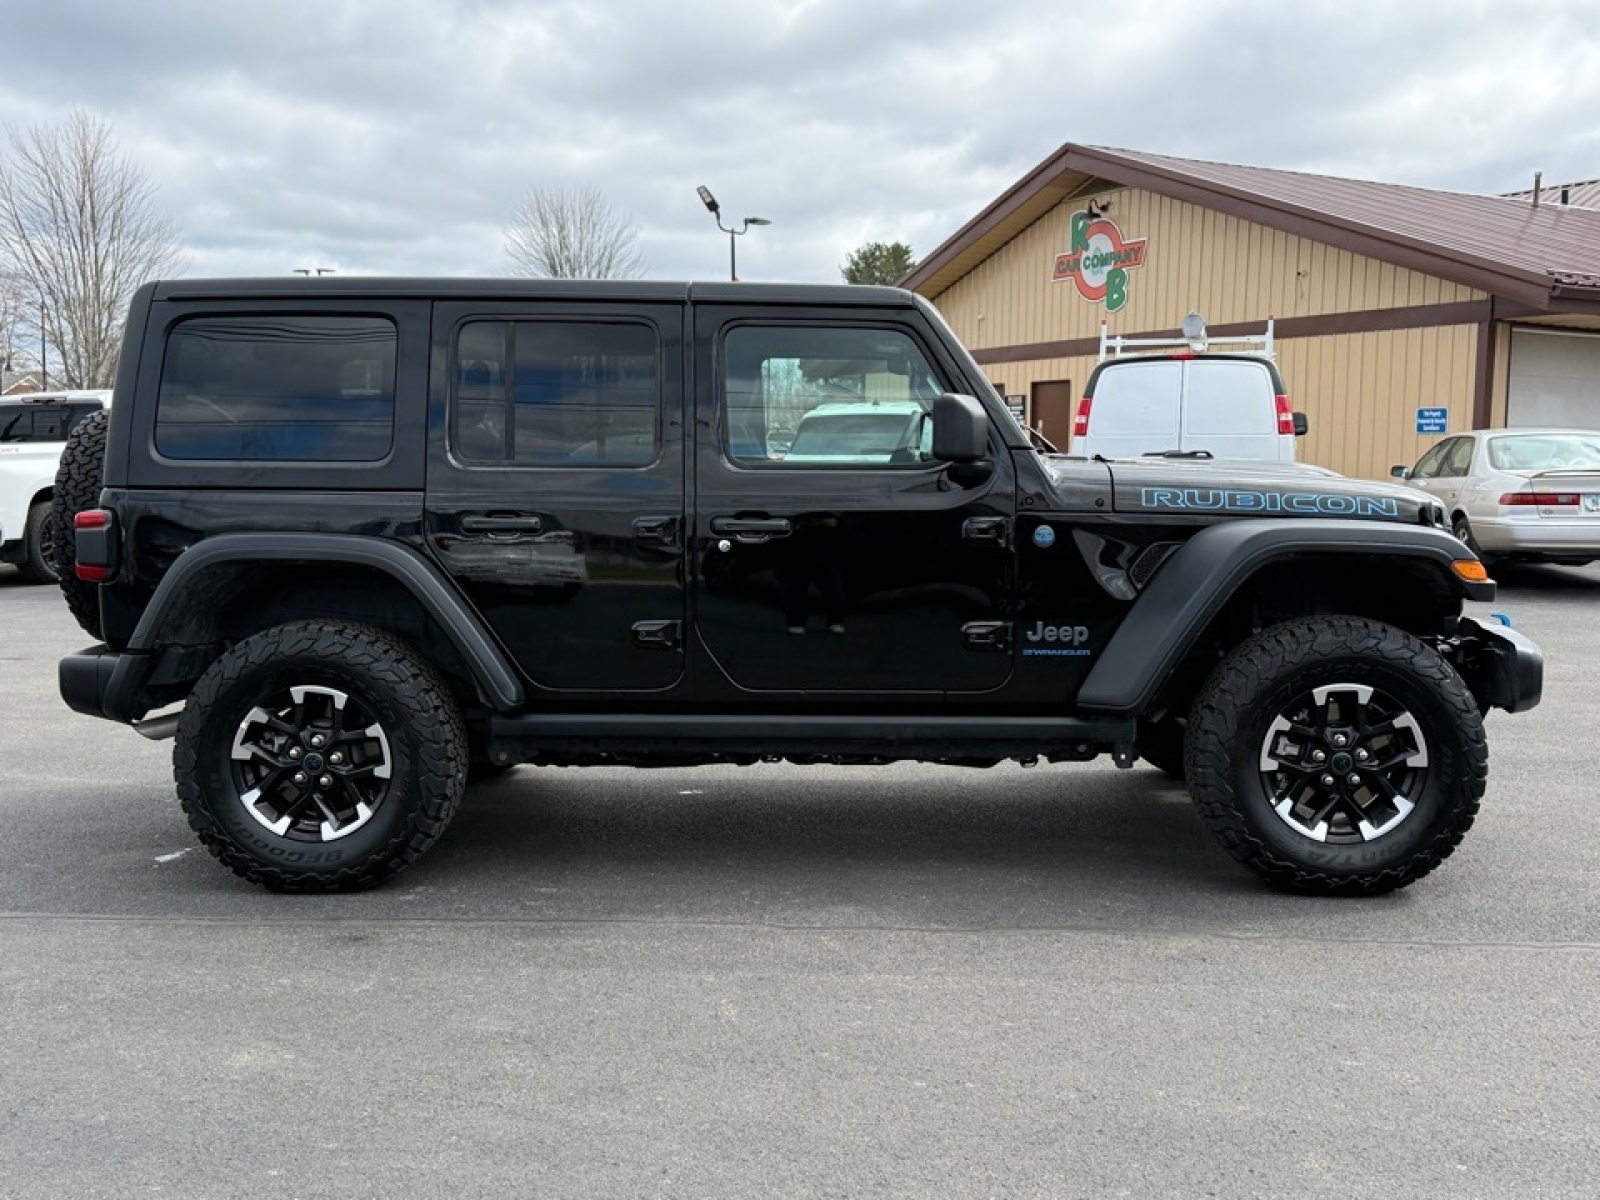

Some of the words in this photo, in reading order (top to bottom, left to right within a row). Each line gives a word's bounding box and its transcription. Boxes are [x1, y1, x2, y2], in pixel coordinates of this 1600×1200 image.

[1056, 257, 1081, 275] CAR
[1083, 246, 1143, 271] COMPANY
[1106, 267, 1128, 311] B
[1141, 487, 1399, 516] RUBICON
[1026, 621, 1089, 646] Jeep
